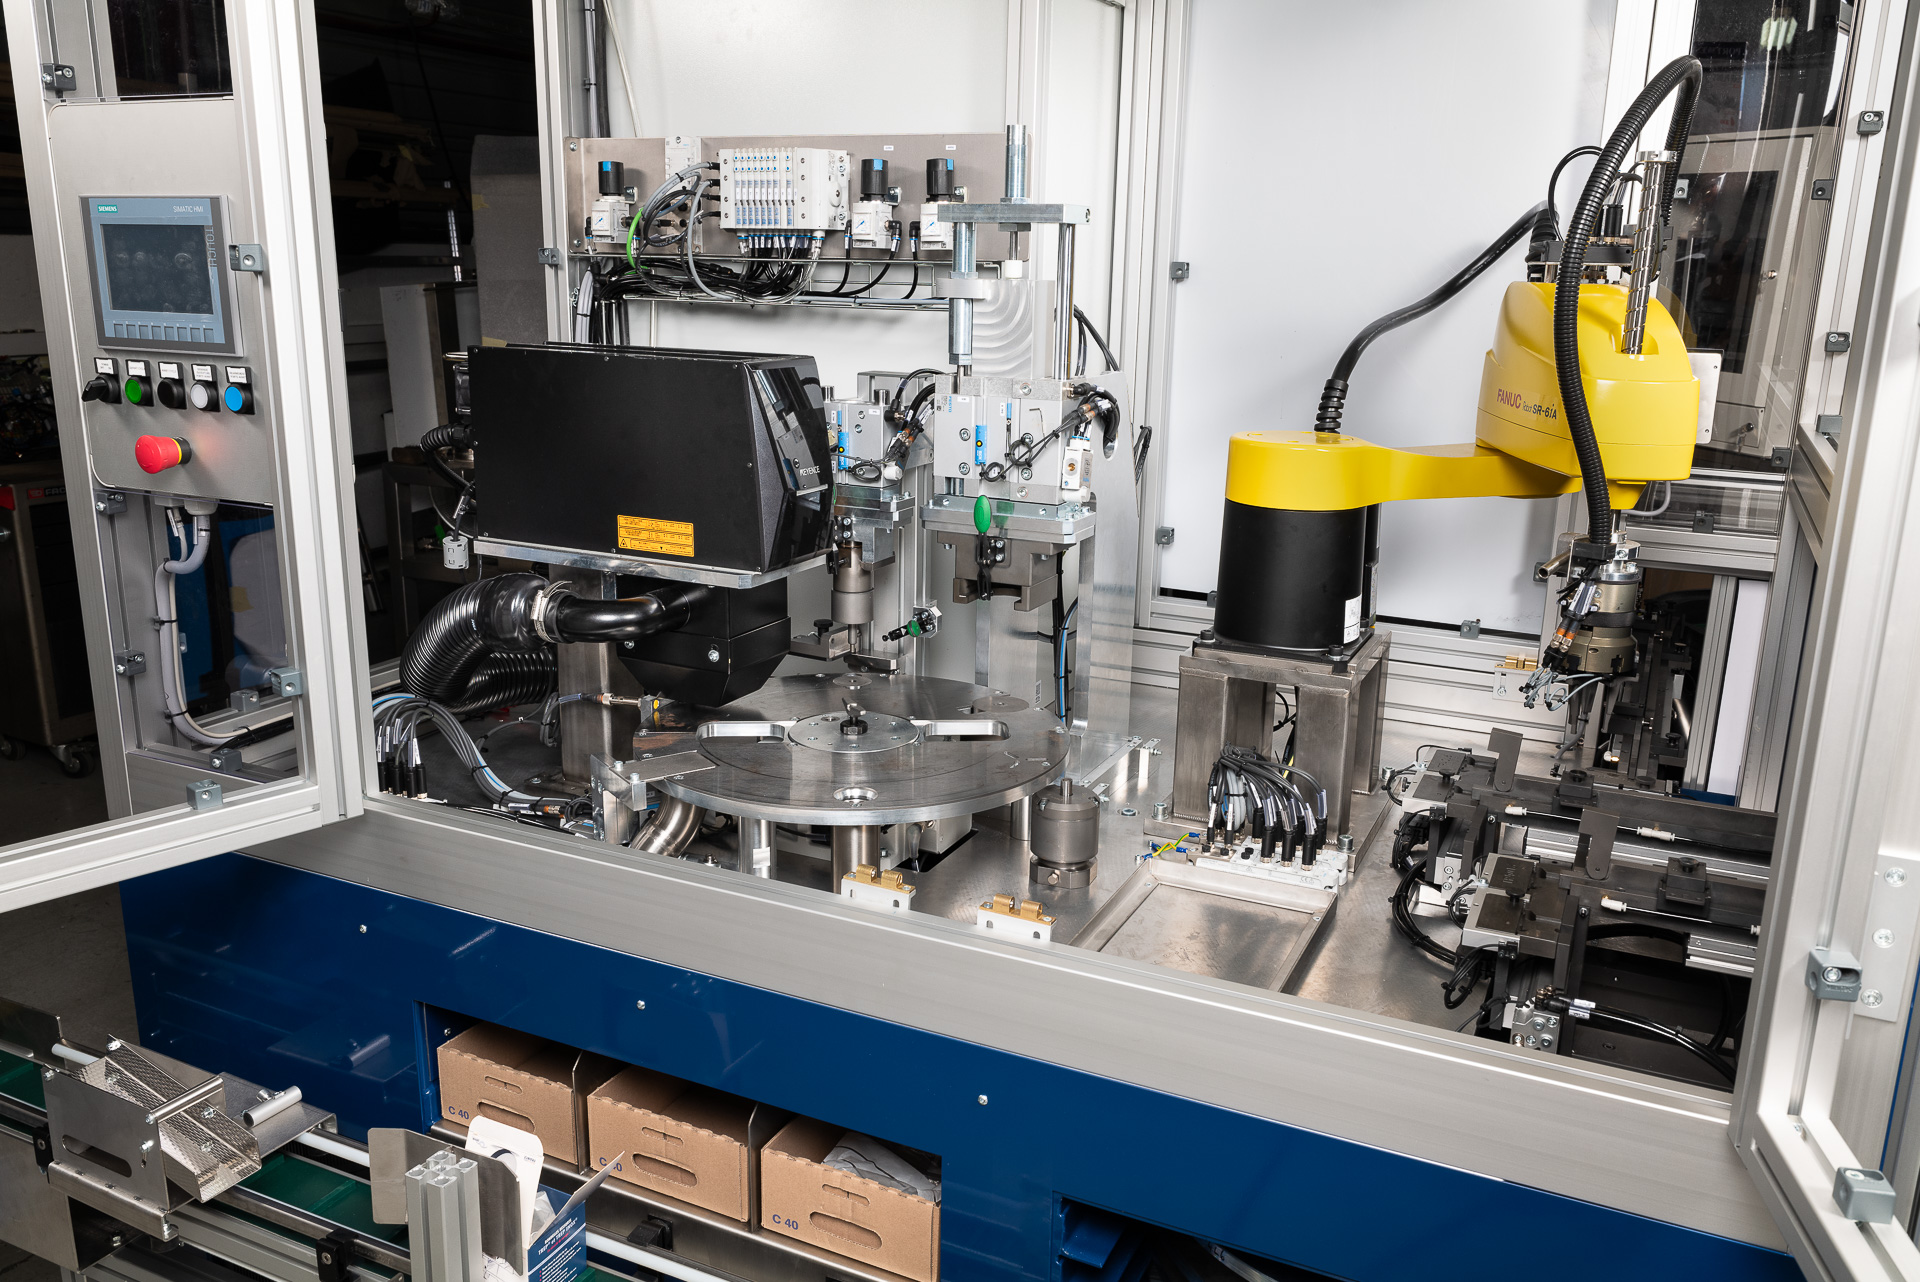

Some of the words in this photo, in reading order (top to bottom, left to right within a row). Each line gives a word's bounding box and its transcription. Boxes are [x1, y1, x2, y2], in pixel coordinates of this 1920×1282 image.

[173, 205, 193, 213] SIMATIC
[205, 226, 218, 268] TOUCH
[1497, 389, 1522, 408] FANUC
[799, 465, 821, 476] KEYENCE
[448, 1105, 456, 1115] C
[458, 1109, 470, 1120] 40
[599, 1156, 608, 1167] C
[612, 1162, 623, 1172] 0
[772, 1213, 782, 1224] C
[784, 1218, 799, 1231] 40
